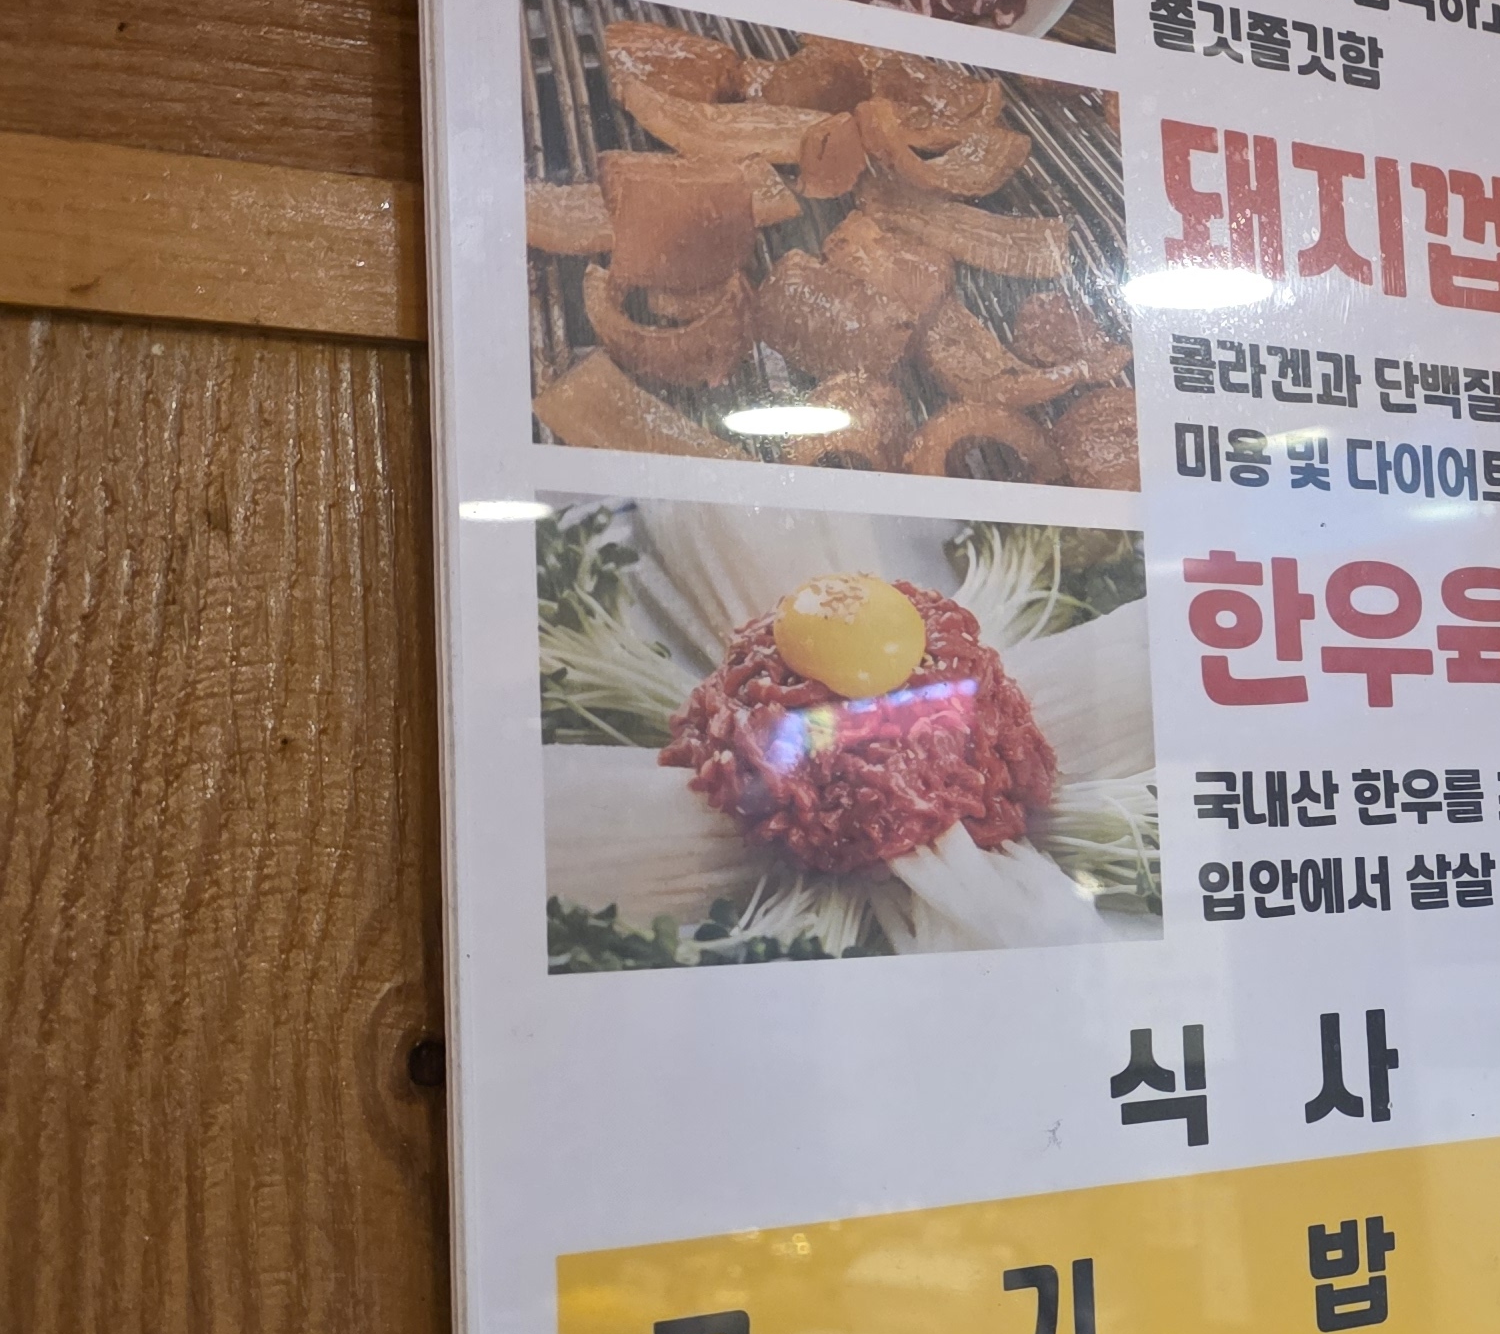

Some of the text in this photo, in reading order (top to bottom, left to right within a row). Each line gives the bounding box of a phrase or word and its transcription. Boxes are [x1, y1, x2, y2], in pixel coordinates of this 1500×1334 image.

[1169, 332, 1361, 409] 콜라겐과
[1173, 422, 1271, 489] 미용
[1288, 431, 1331, 491] 및
[1193, 768, 1339, 830] 국내산
[1351, 767, 1485, 825] 한우를
[1199, 854, 1391, 922] 입안에서
[1405, 852, 1496, 911] 살살
